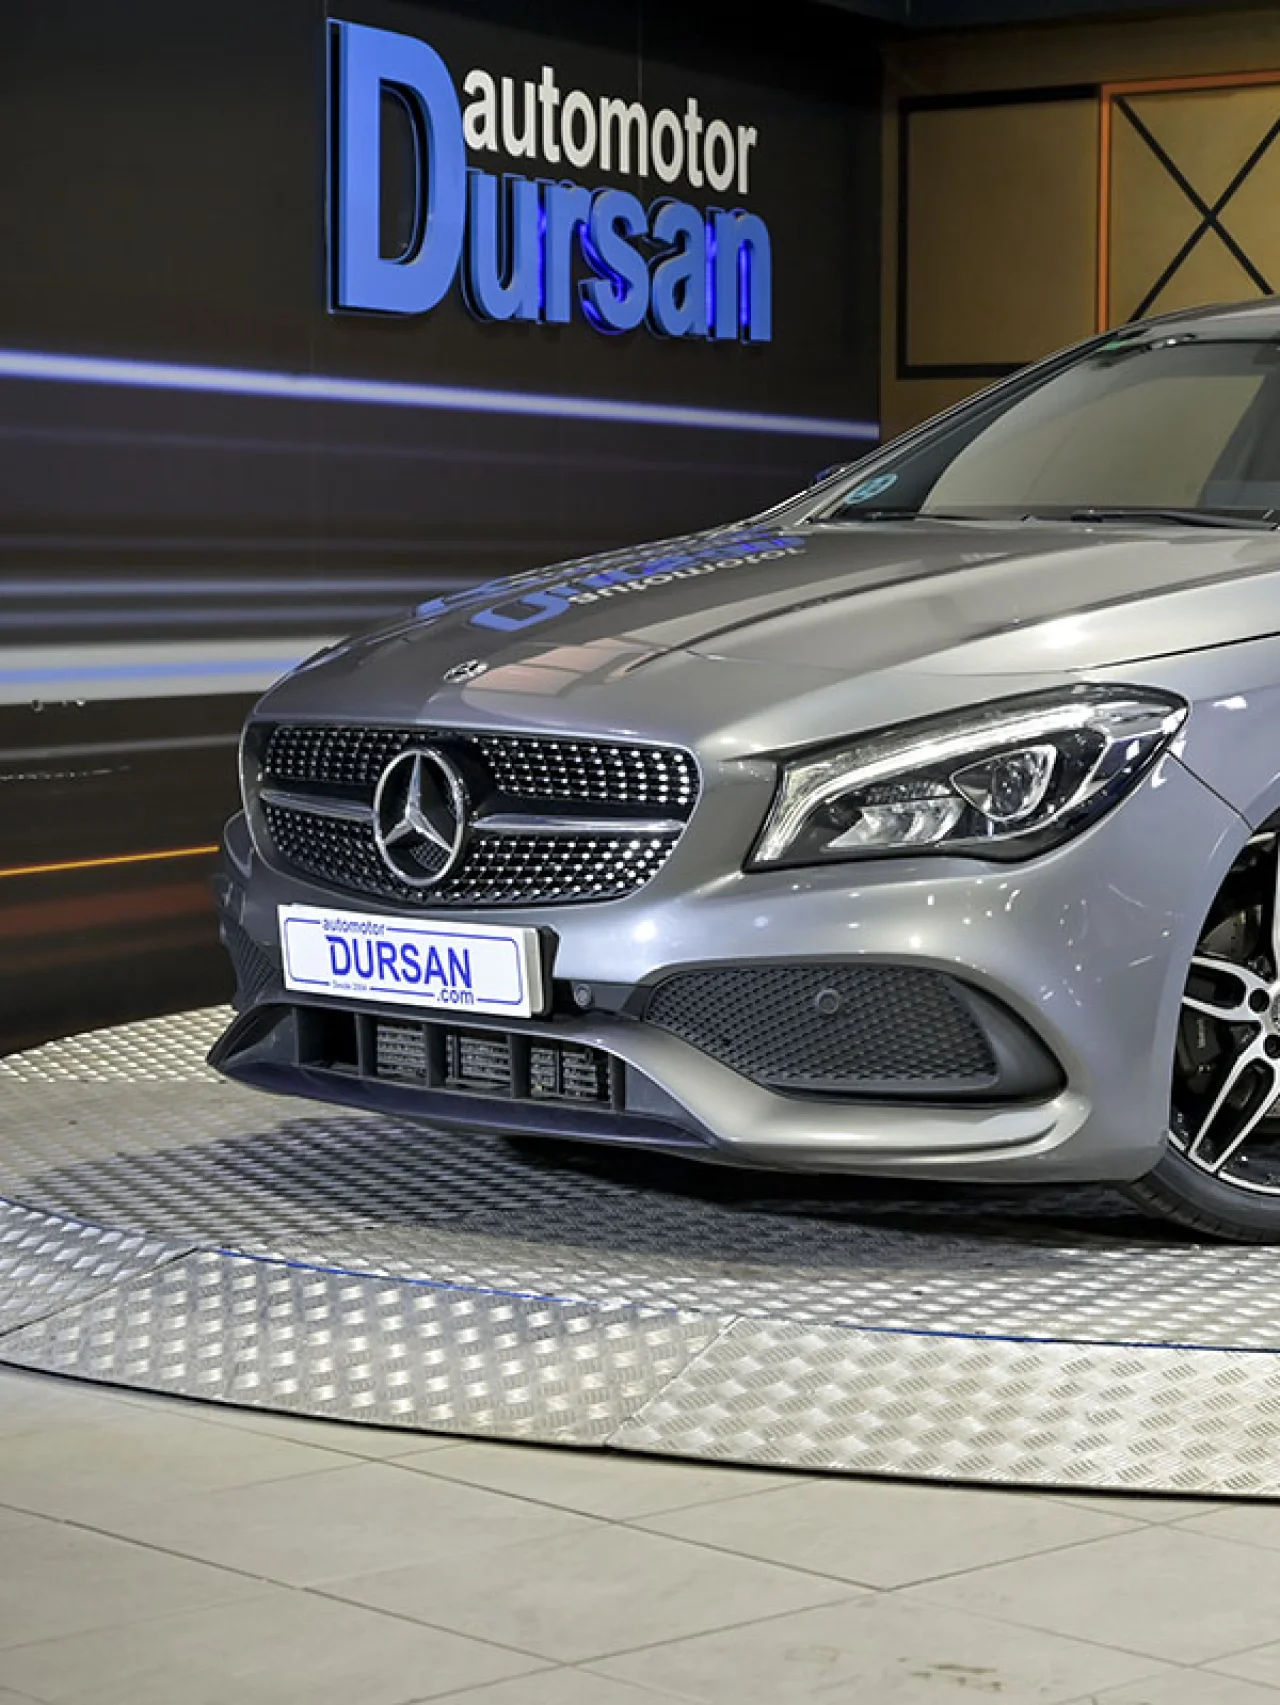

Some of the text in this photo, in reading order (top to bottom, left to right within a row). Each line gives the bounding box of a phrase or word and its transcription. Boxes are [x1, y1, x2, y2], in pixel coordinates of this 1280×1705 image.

[462, 65, 758, 194] automotor
[327, 16, 772, 343] Dursan
[321, 917, 385, 936] automotor
[325, 934, 473, 989] DURSAN
[436, 987, 475, 1006] .com
